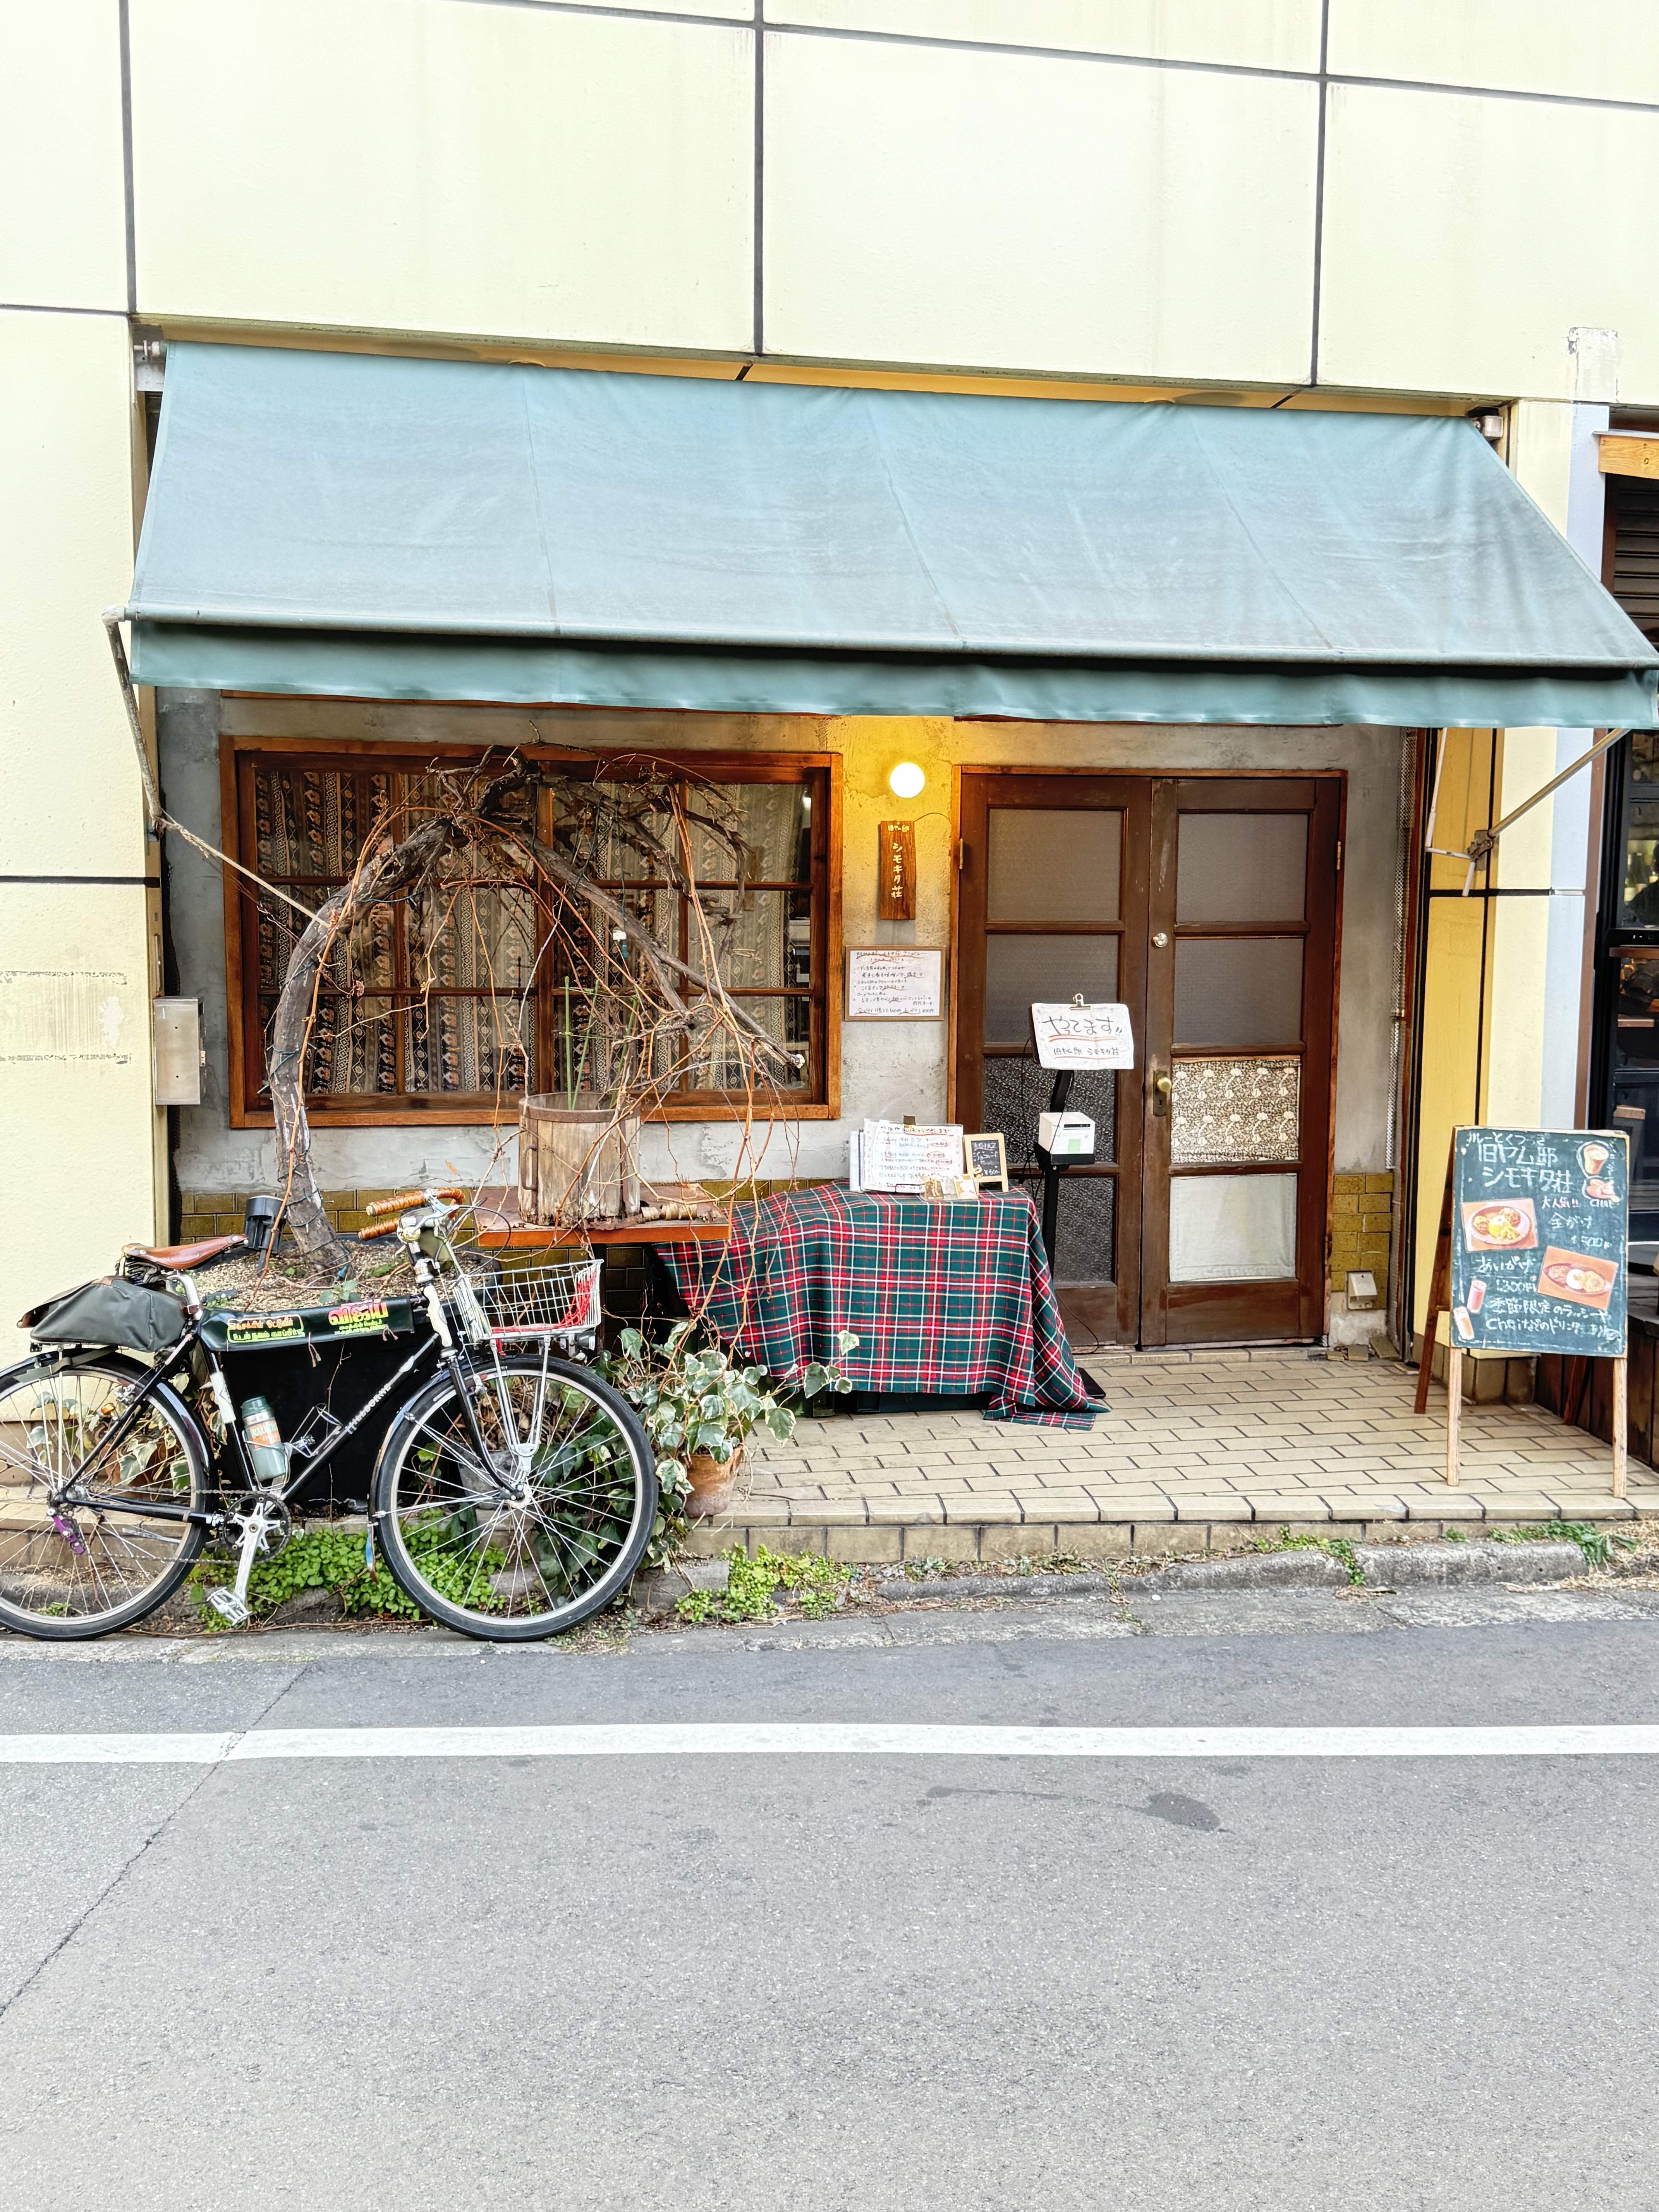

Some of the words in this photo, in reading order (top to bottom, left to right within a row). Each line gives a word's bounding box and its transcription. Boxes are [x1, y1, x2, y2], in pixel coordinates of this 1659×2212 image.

[891, 842, 903, 899] シモキタ荘
[1478, 1144, 1558, 1168] 旧ヤム邸
[1482, 1167, 1573, 1194] シモキタ荘
